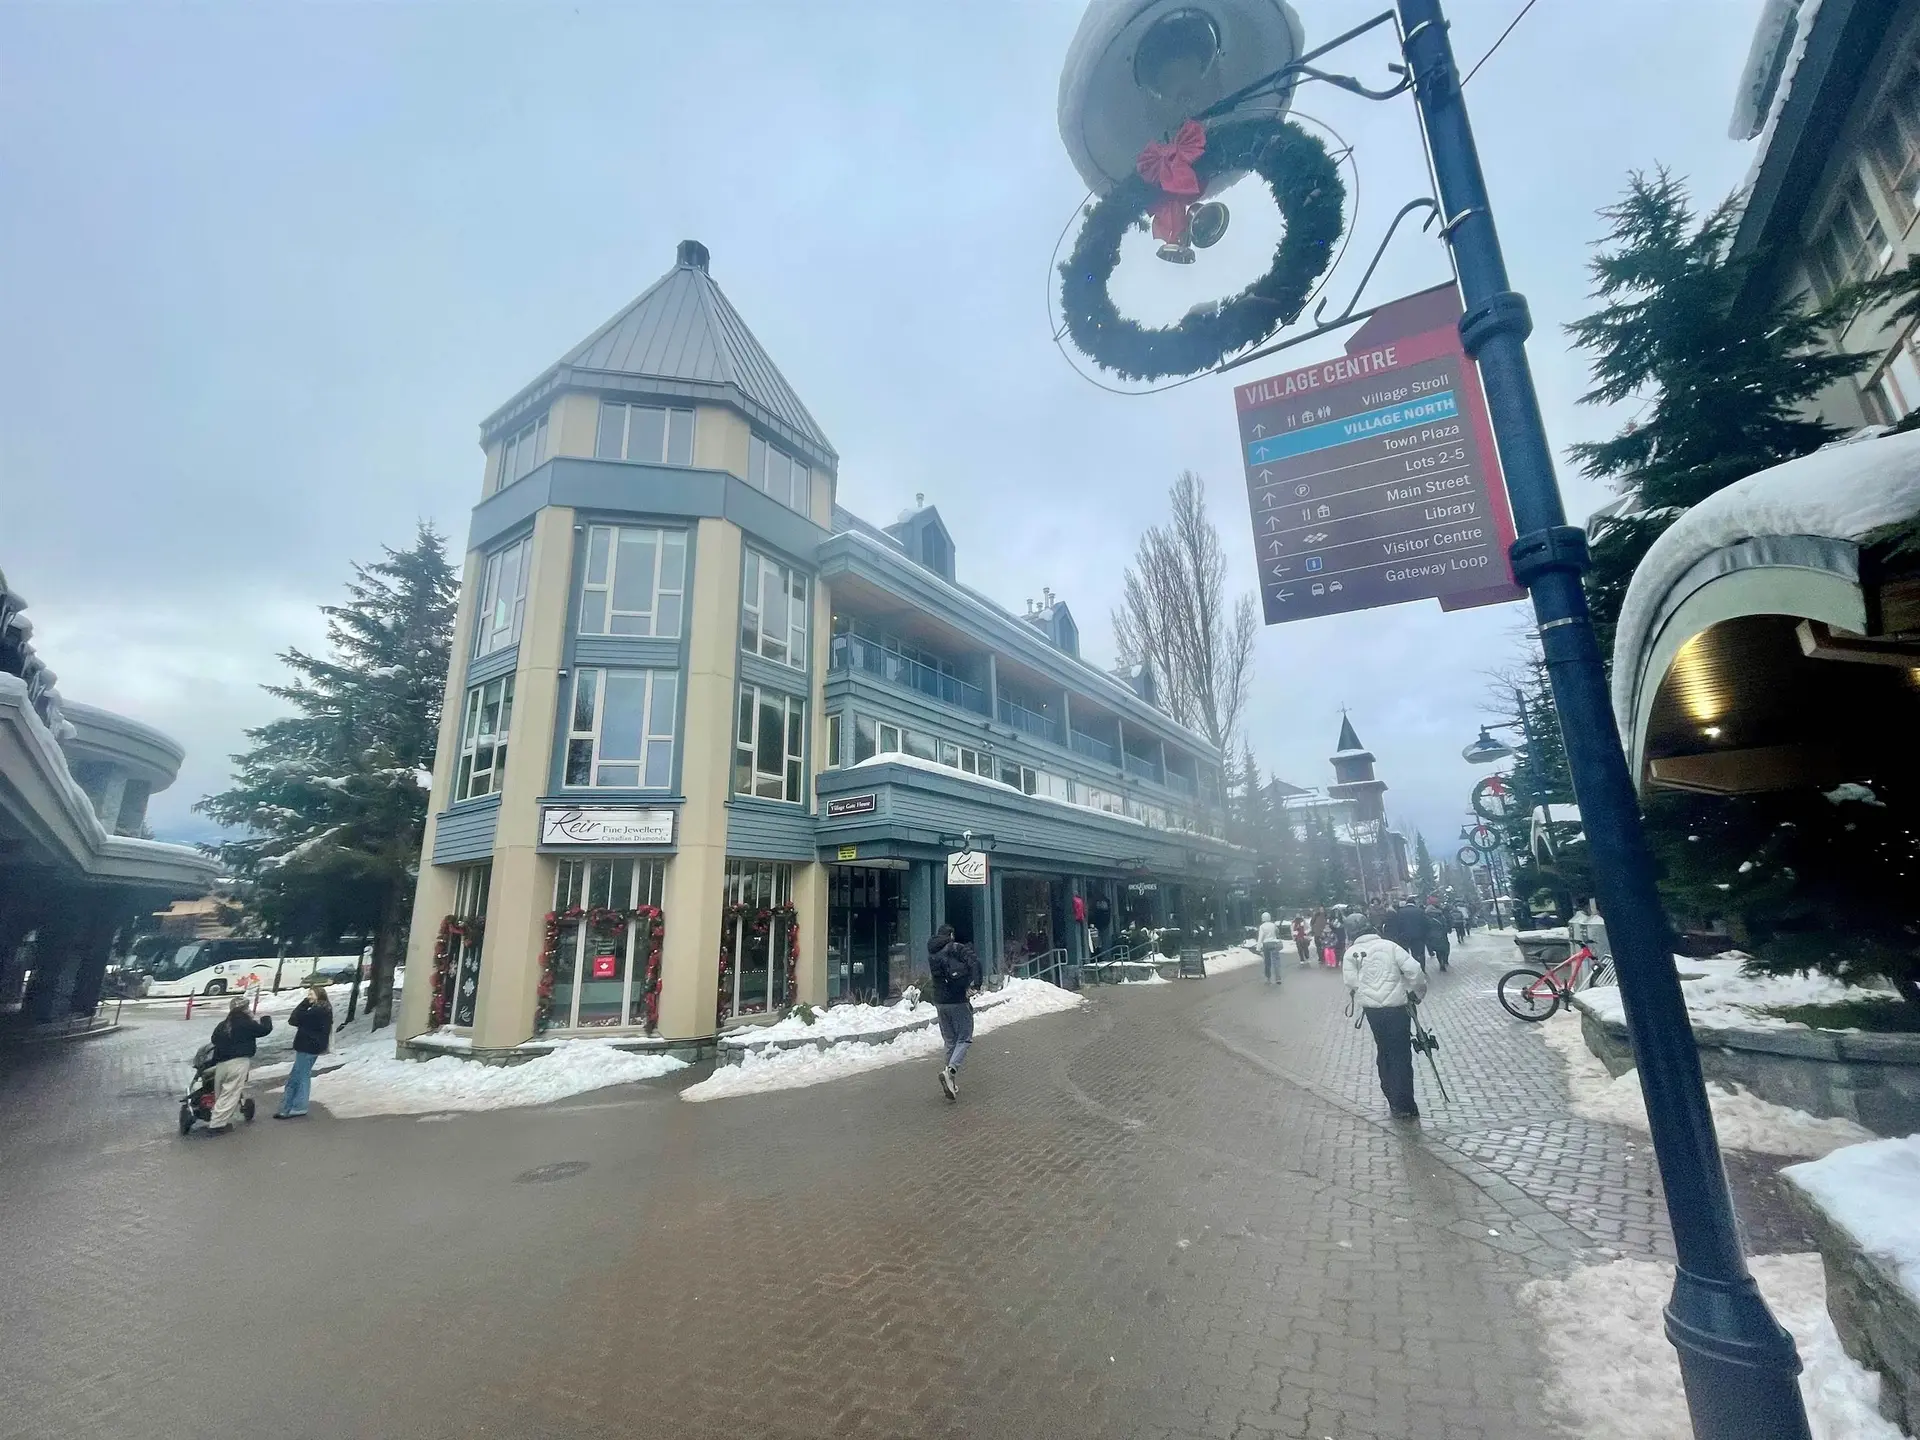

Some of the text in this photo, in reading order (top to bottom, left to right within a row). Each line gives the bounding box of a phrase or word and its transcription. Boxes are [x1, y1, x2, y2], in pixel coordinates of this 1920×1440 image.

[1245, 347, 1398, 405] VILLAGE CENTRE
[1361, 374, 1449, 406] Village Stroll
[1343, 398, 1455, 436] VILLAGE NORTH
[1383, 424, 1460, 451] Town Plaza
[1405, 448, 1465, 472] Lots 2-5
[1386, 474, 1471, 502] Main Street
[1425, 501, 1476, 520] Library
[1383, 528, 1482, 555] Visitor Centre
[1385, 554, 1488, 582] Gateway Loop
[547, 811, 601, 841] Keir
[603, 825, 664, 835] Fine Jewellery
[951, 854, 984, 880] Keir
